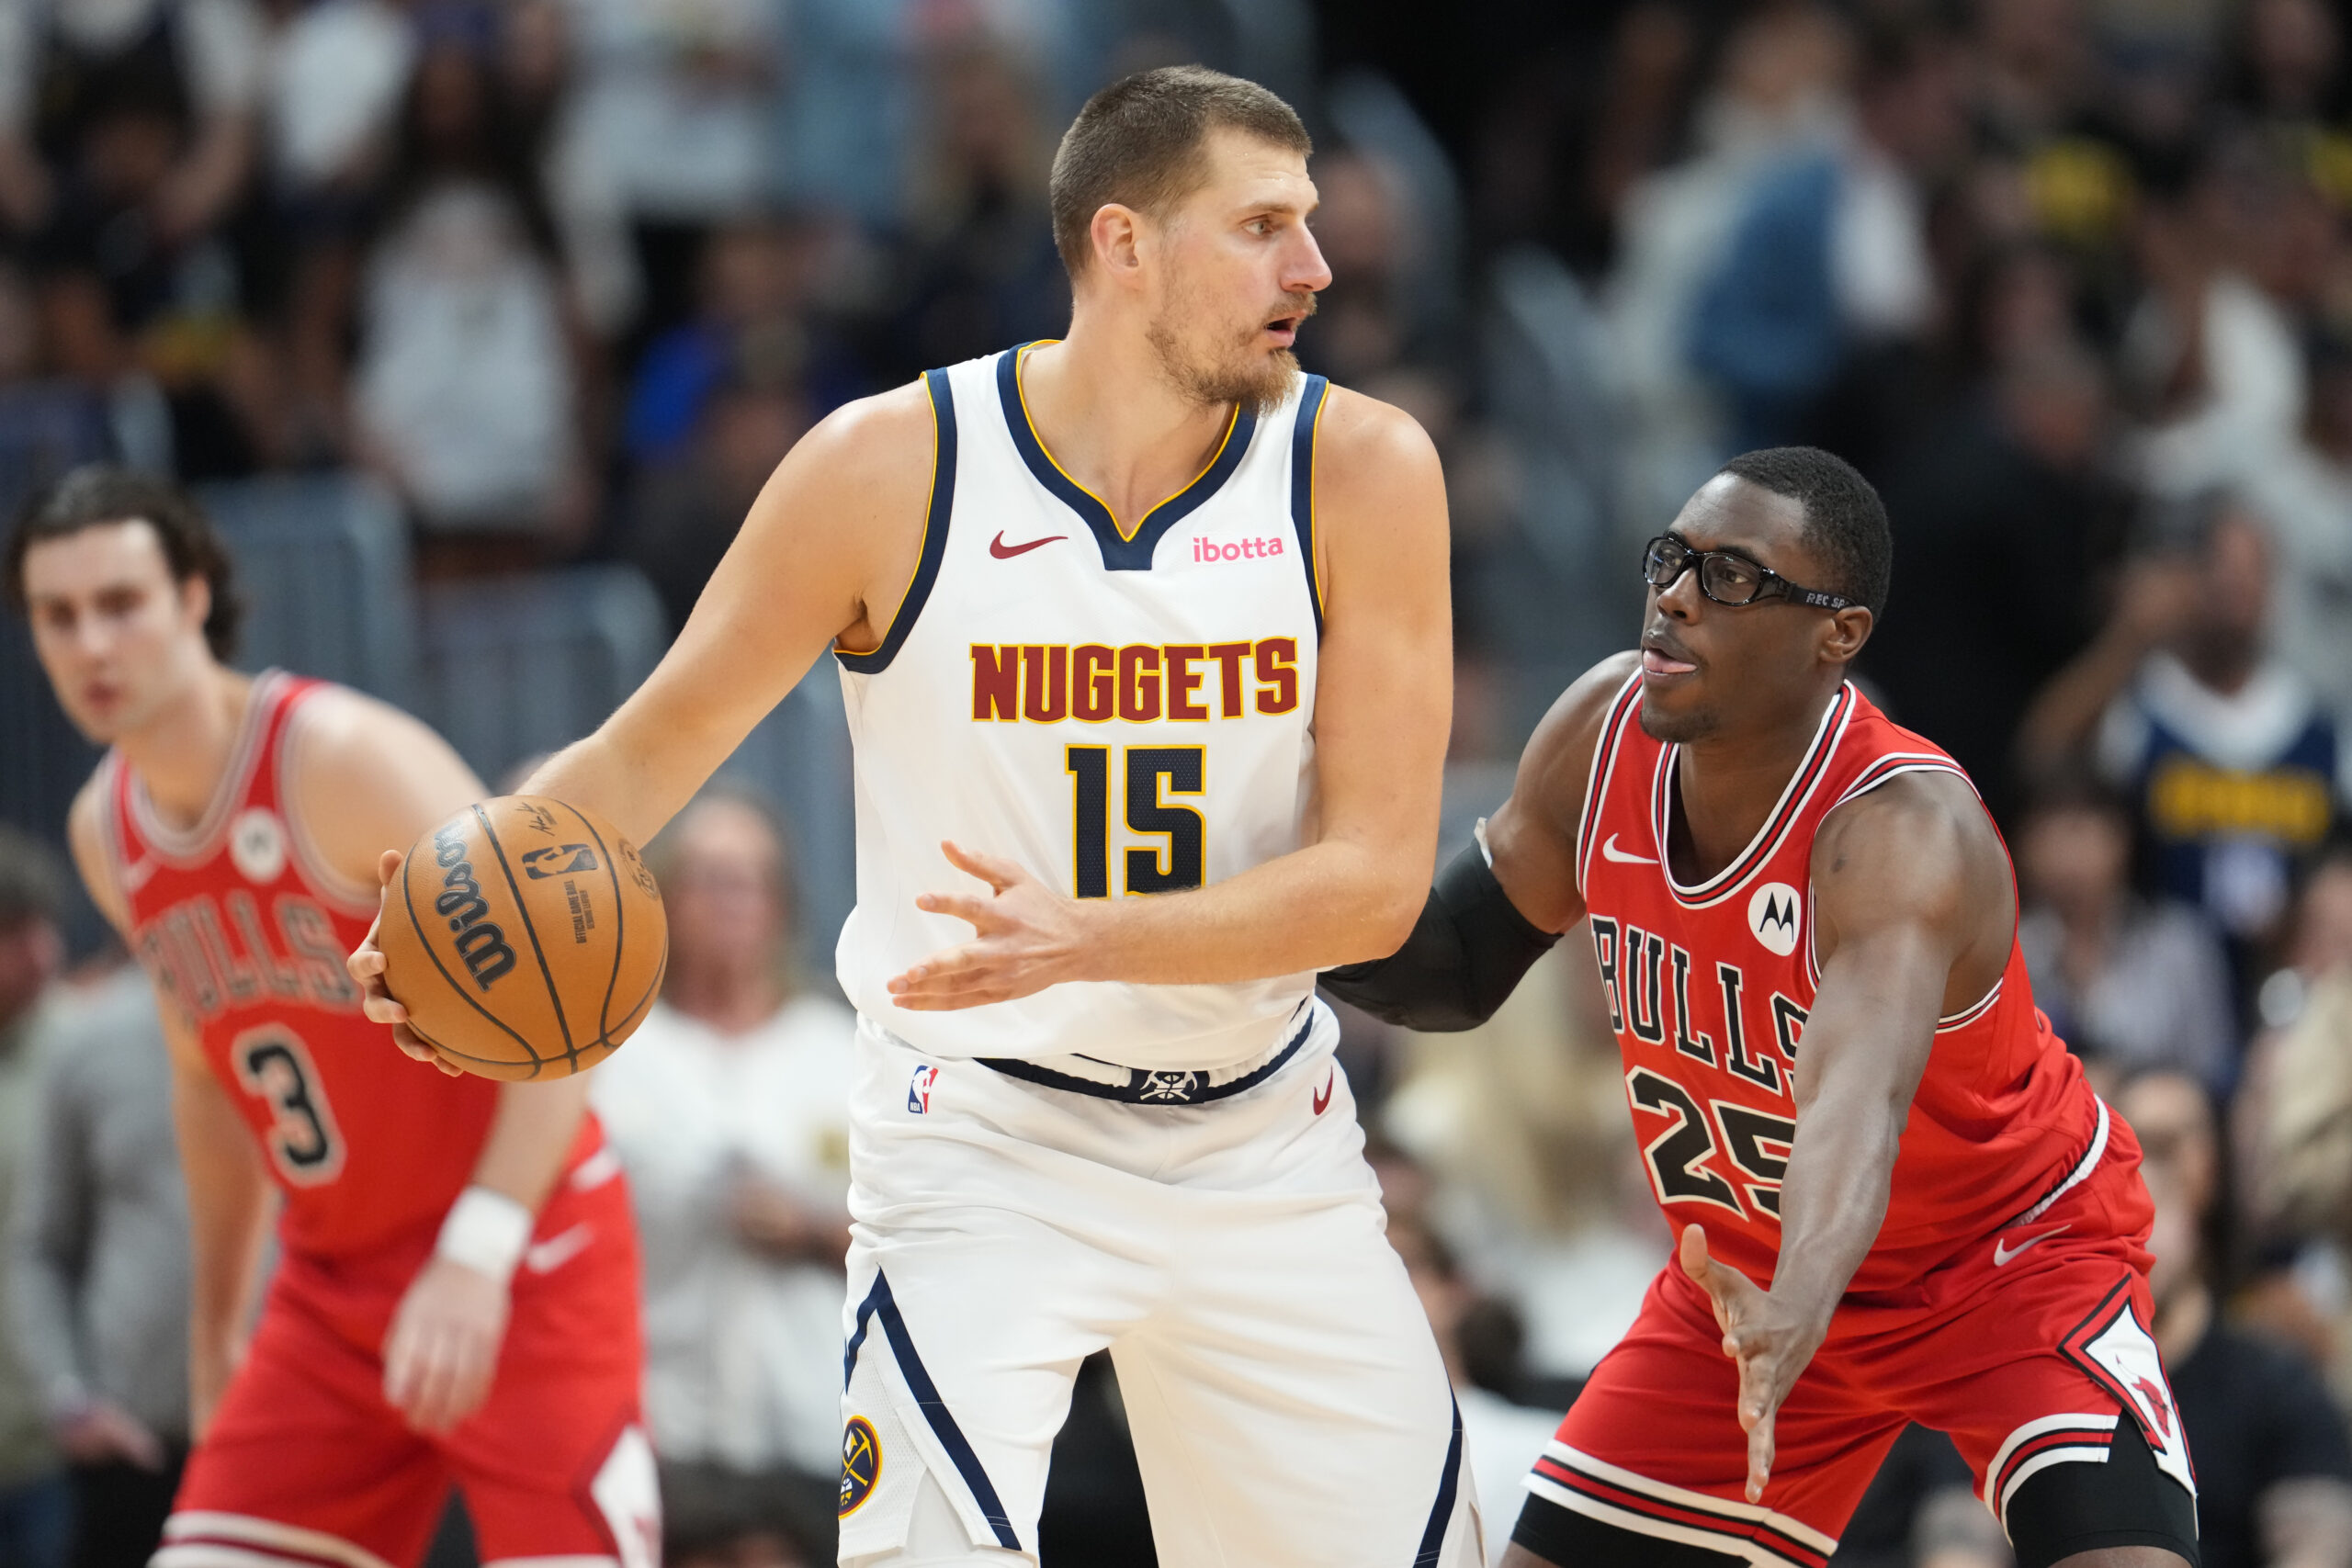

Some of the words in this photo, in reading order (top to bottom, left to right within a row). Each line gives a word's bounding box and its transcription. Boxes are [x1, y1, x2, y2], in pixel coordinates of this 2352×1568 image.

[1193, 536, 1283, 562] ibotta
[1806, 592, 1829, 606] REC
[969, 636, 1299, 724] NUGGETS
[1065, 742, 1206, 899] 15
[231, 1021, 347, 1189] 3
[1625, 1066, 1797, 1223] 25
